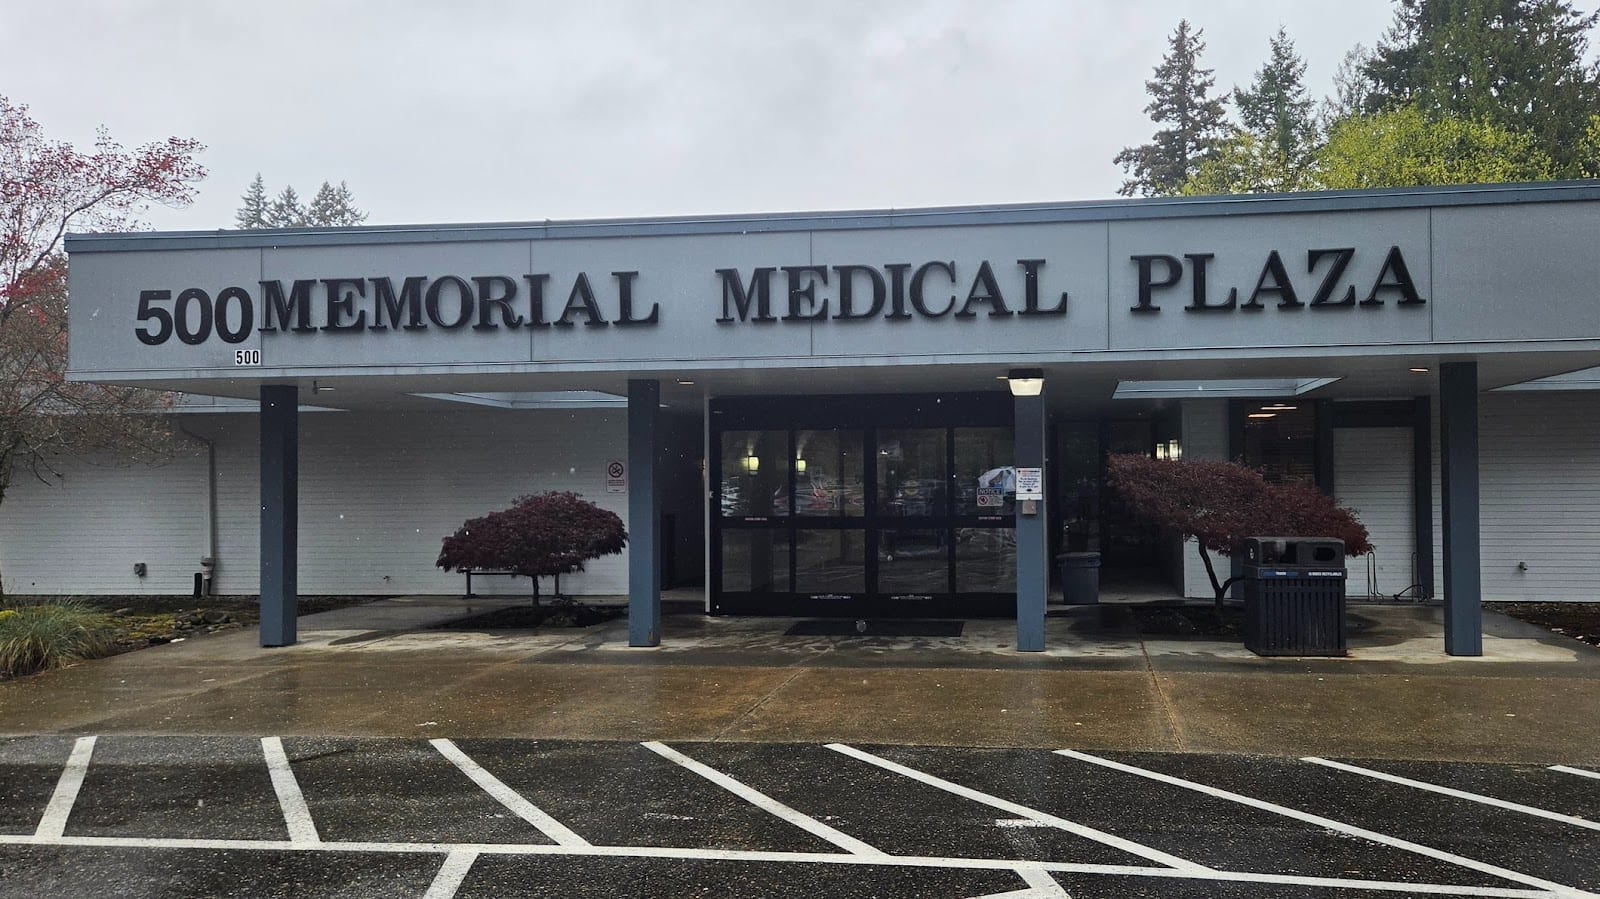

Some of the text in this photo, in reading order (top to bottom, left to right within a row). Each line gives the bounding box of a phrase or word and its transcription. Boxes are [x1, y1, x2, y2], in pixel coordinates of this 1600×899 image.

[135, 287, 253, 346] 500
[257, 245, 1427, 332] MEMORIAL MEDICAL PLAZA
[236, 350, 259, 364] 500
